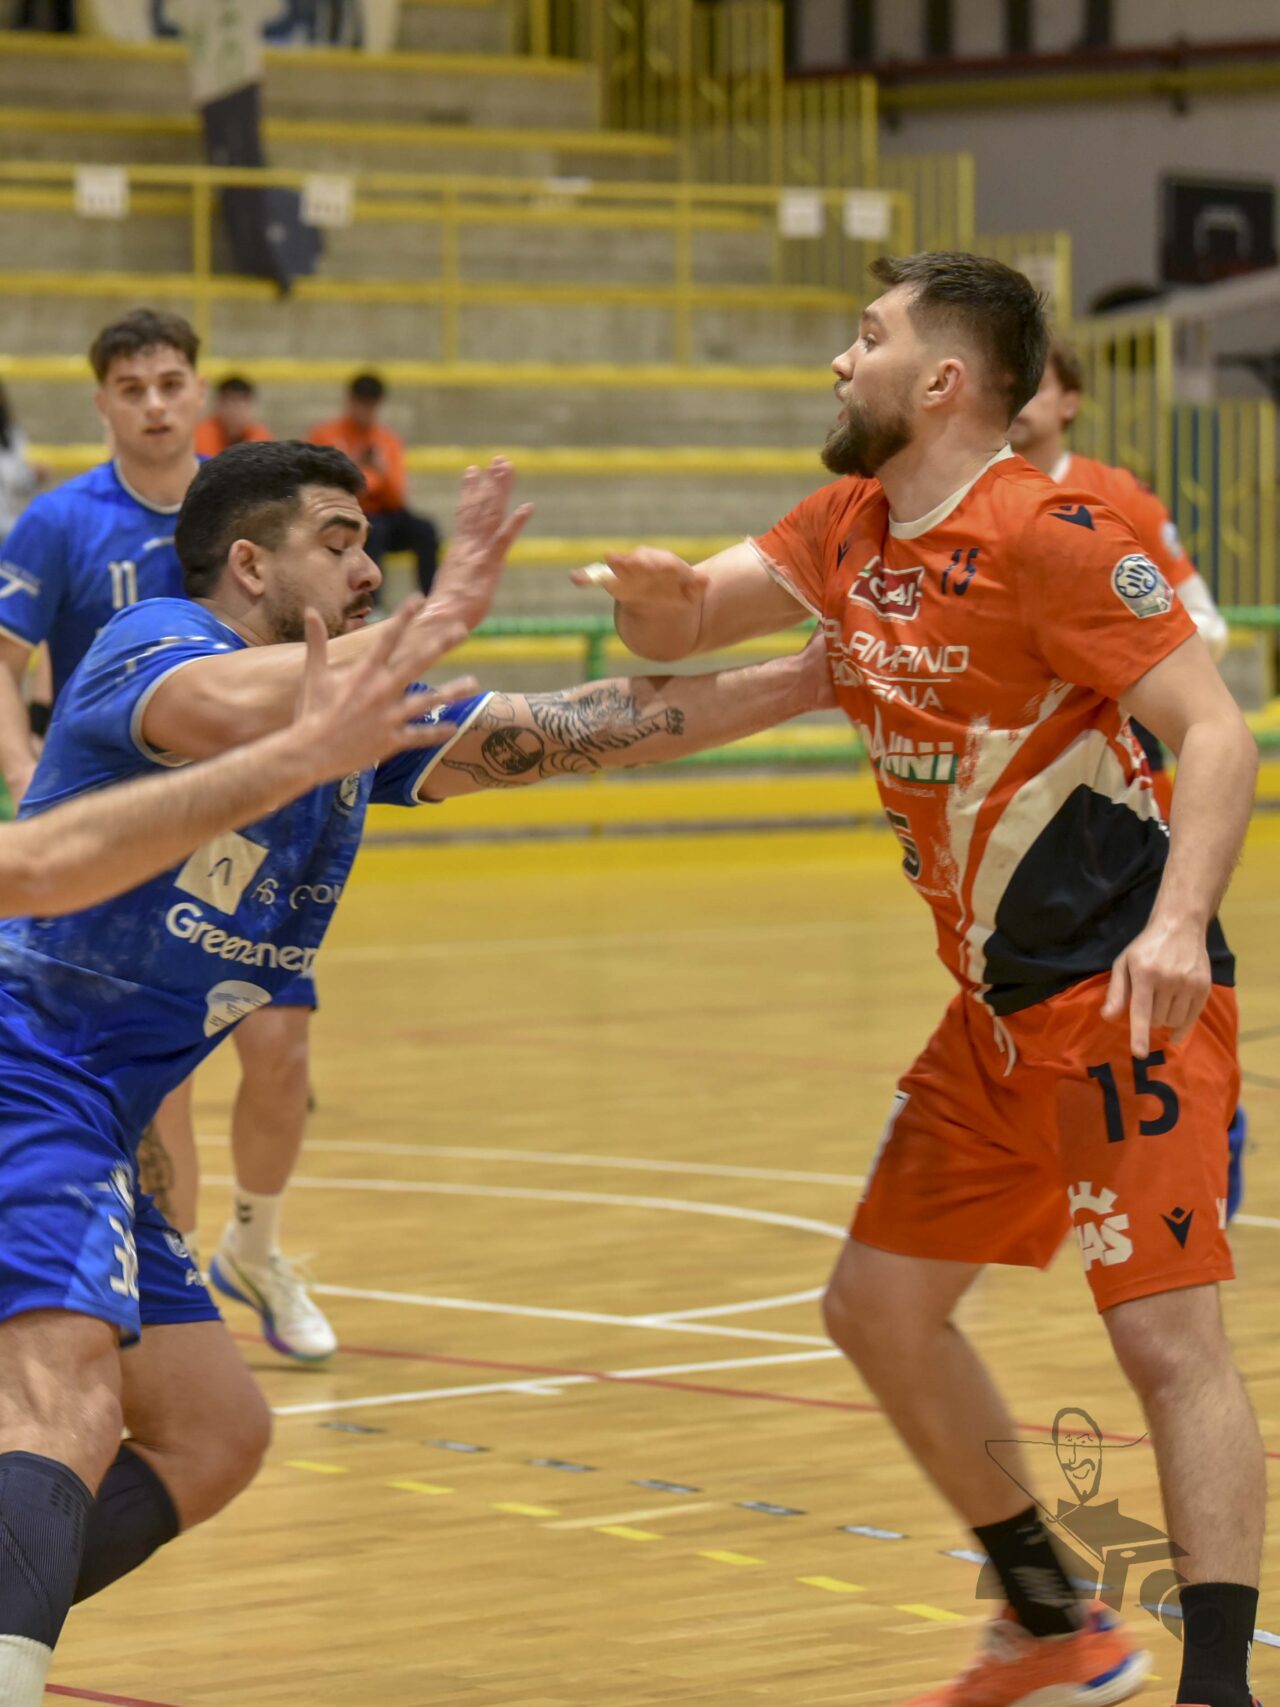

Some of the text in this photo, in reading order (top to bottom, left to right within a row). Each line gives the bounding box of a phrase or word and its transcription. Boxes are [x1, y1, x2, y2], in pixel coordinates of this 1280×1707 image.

[108, 561, 138, 610] 11
[940, 549, 980, 596] 15
[1087, 1050, 1179, 1143] 15
